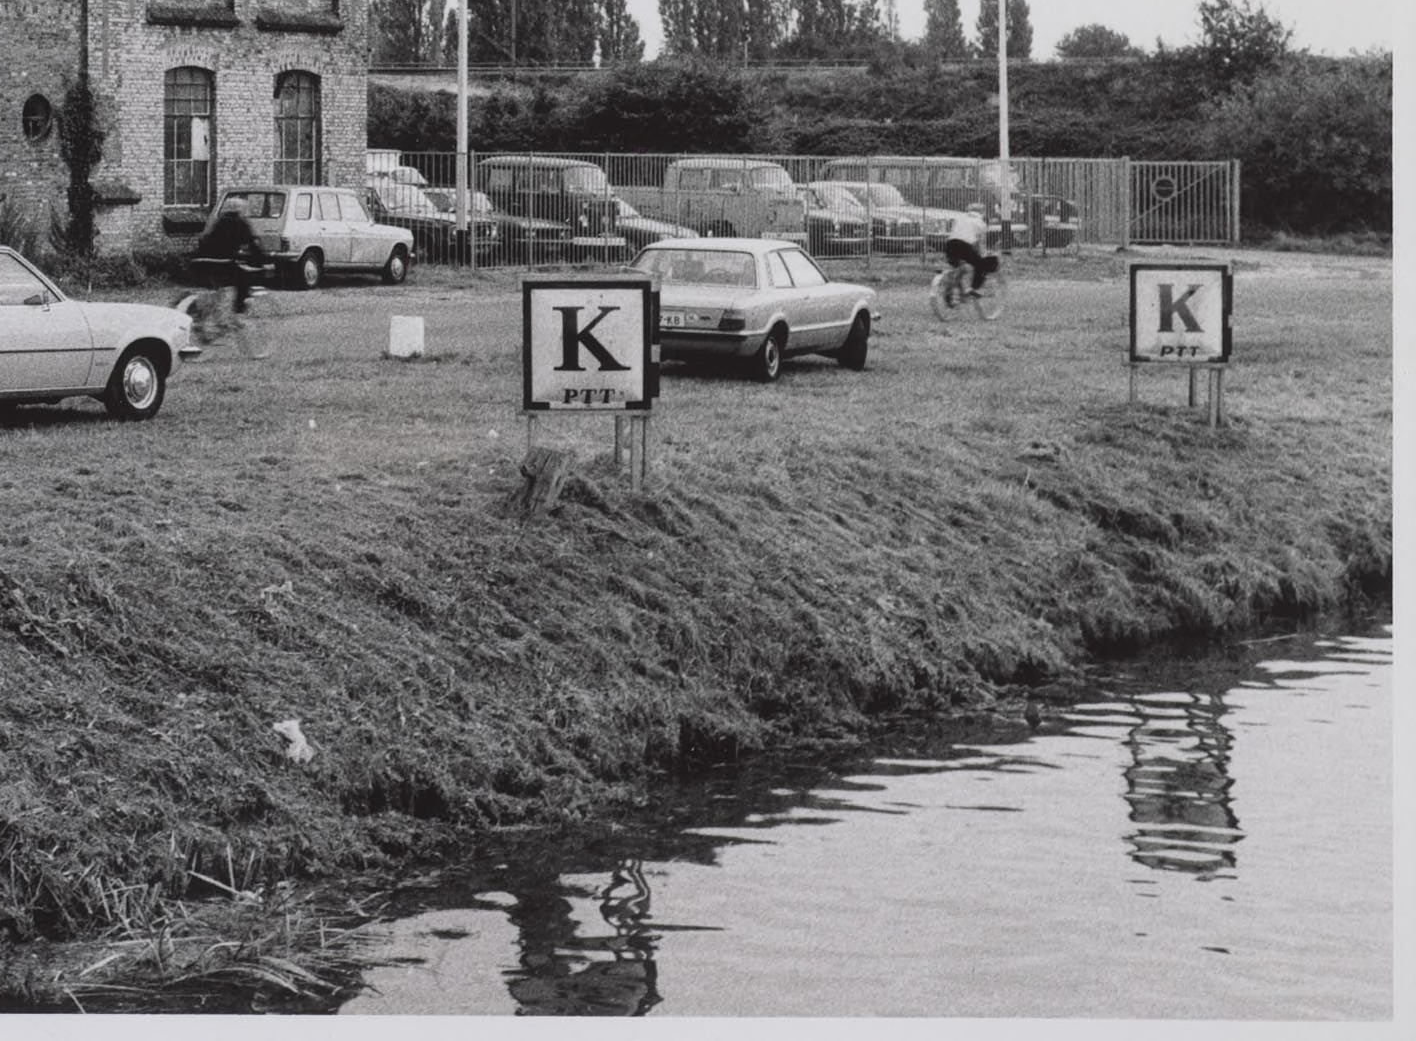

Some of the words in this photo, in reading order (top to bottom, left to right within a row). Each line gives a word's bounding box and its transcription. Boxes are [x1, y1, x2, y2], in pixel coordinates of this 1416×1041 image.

[1157, 283, 1205, 333] K
[552, 306, 632, 371] K
[1160, 345, 1200, 358] PTT
[562, 388, 616, 404] PTT
